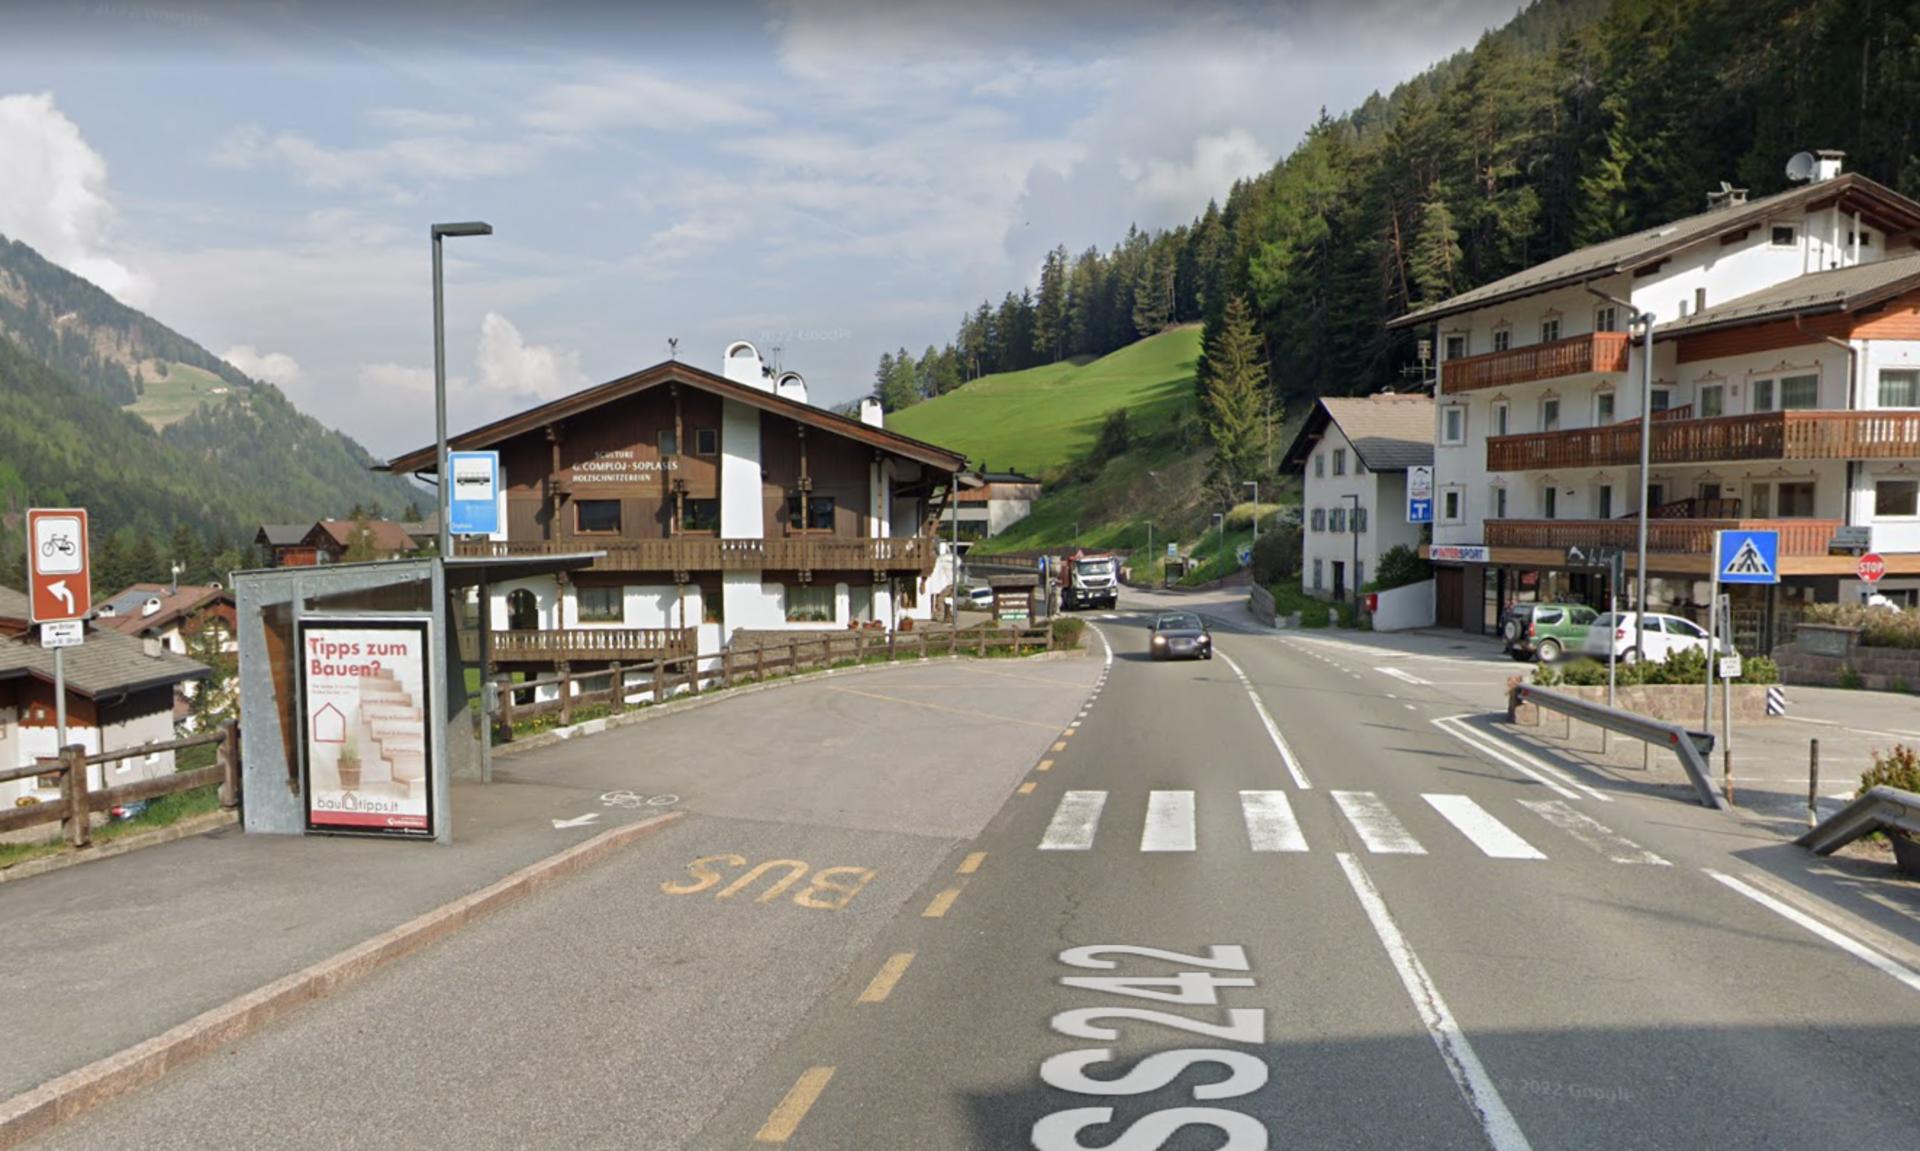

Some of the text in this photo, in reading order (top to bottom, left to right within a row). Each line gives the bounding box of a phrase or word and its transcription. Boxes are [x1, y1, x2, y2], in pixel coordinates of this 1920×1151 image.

[1859, 560, 1884, 575] STOP
[309, 637, 407, 660] Tipps zum
[311, 659, 381, 678] Bauen?
[660, 853, 878, 911] BUS
[1031, 944, 1269, 1151] SS242
